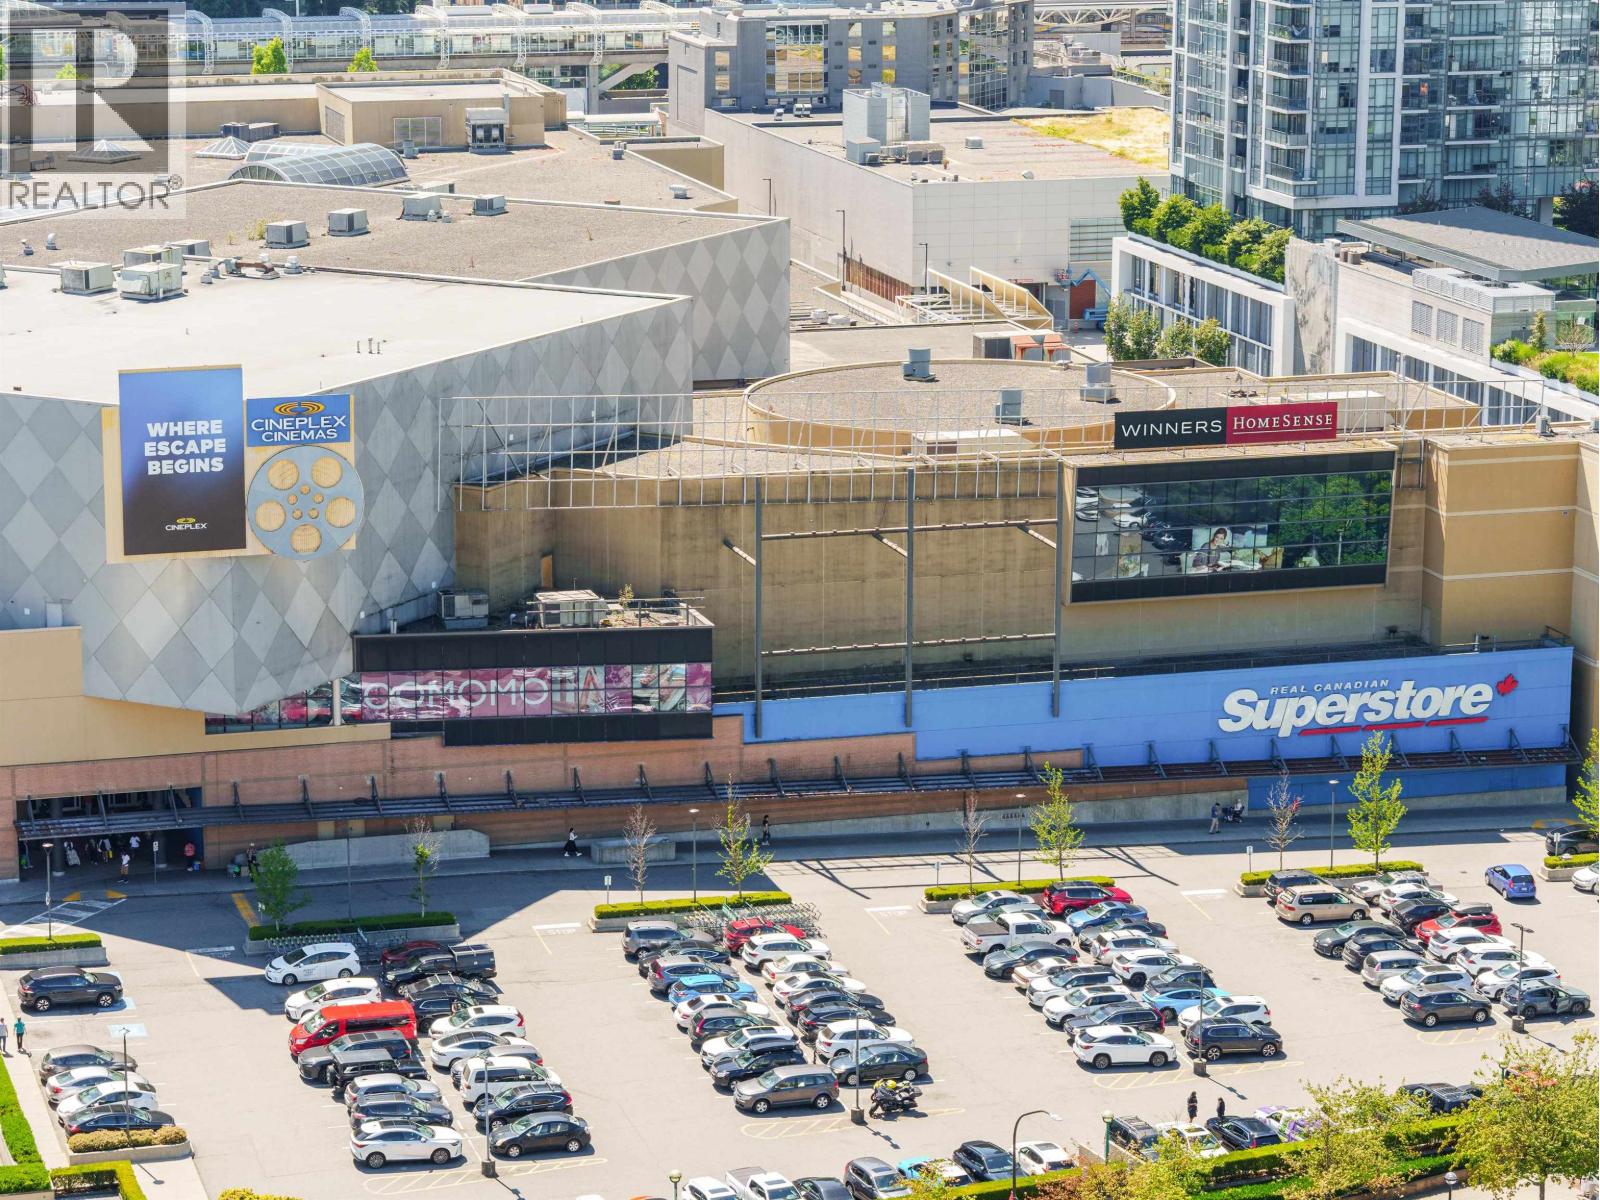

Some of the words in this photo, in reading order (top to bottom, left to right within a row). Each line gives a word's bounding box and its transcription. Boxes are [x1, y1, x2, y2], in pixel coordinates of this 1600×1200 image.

[146, 419, 223, 438] WHERE
[251, 415, 347, 432] CINEPLEX
[1121, 420, 1223, 438] WINNERS
[261, 428, 338, 443] CINEMAS
[144, 438, 227, 457] ESCAPE
[147, 457, 224, 476] BEGINS
[165, 522, 208, 531] CINEPLEX
[1270, 684, 1308, 695] REAL
[1313, 679, 1390, 692] CANADIAN
[1217, 680, 1494, 738] Superstore
